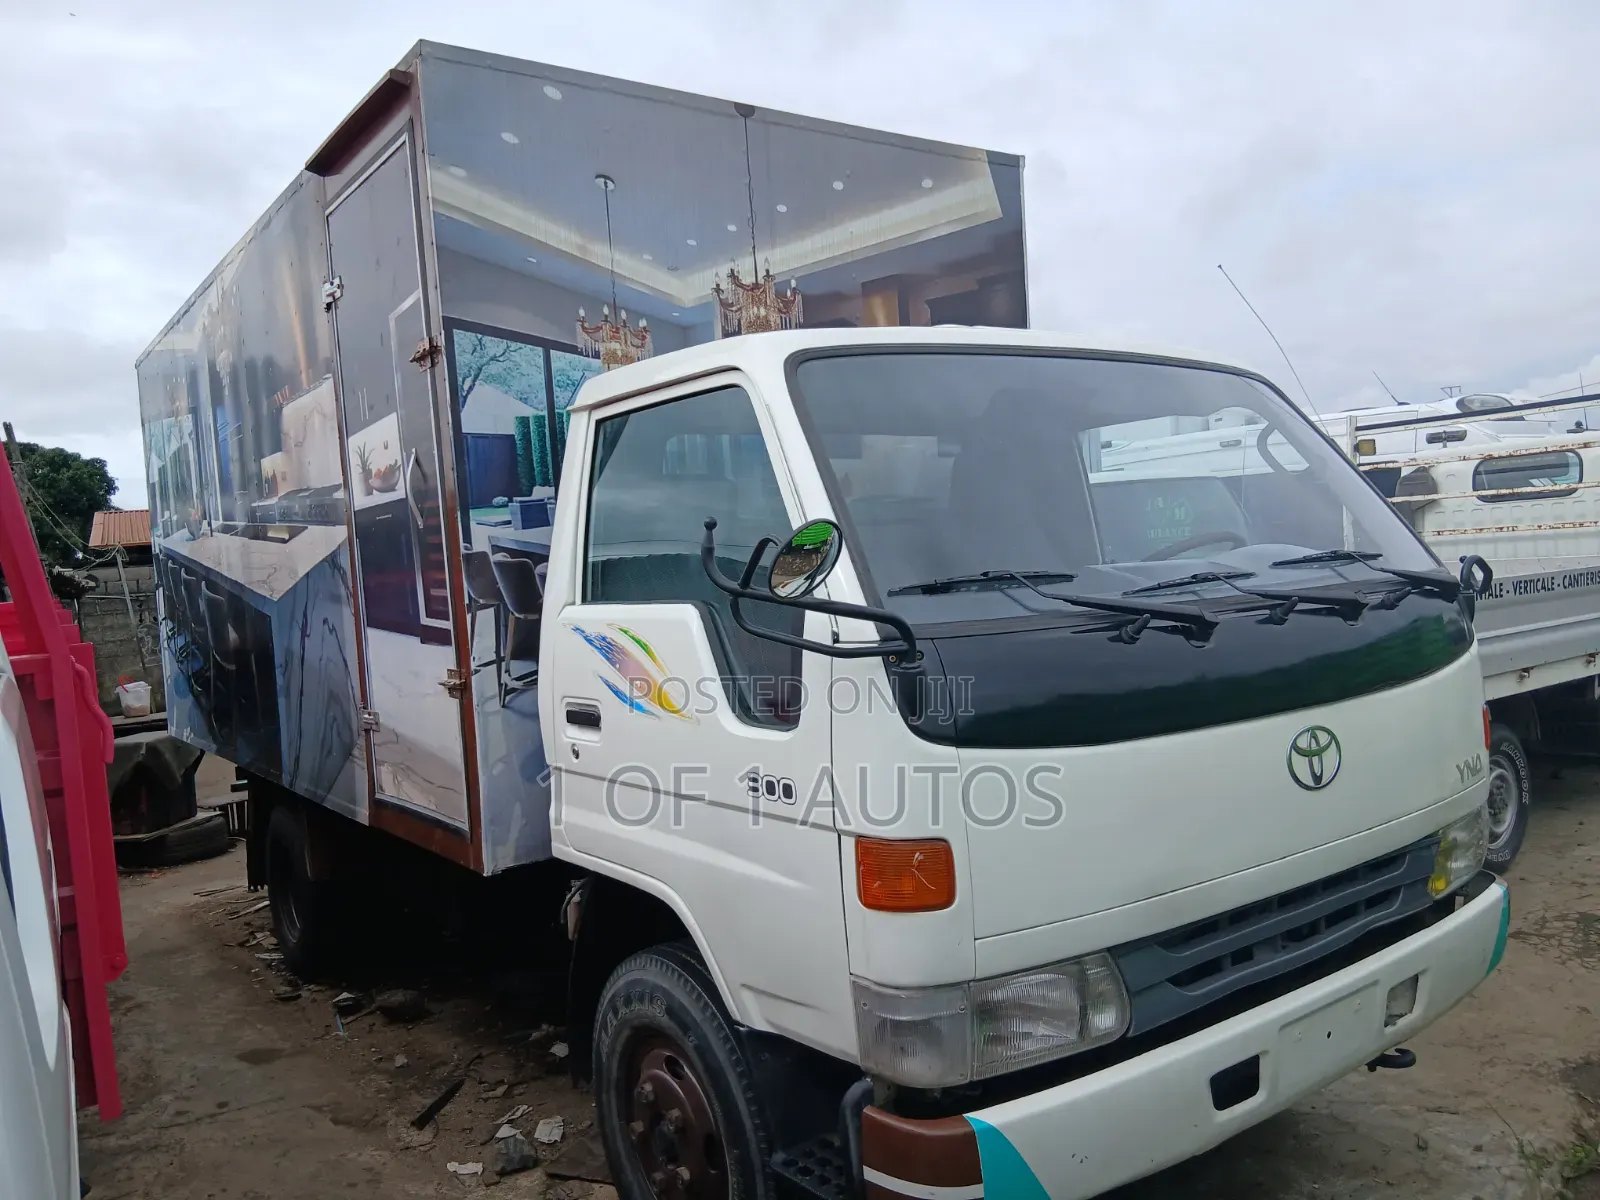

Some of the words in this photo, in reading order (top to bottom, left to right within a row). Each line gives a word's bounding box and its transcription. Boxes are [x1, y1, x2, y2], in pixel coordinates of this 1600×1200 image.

[1512, 576, 1555, 596] VERTICALE
[747, 771, 798, 806] 300
[1500, 742, 1529, 805] HANKOOK
